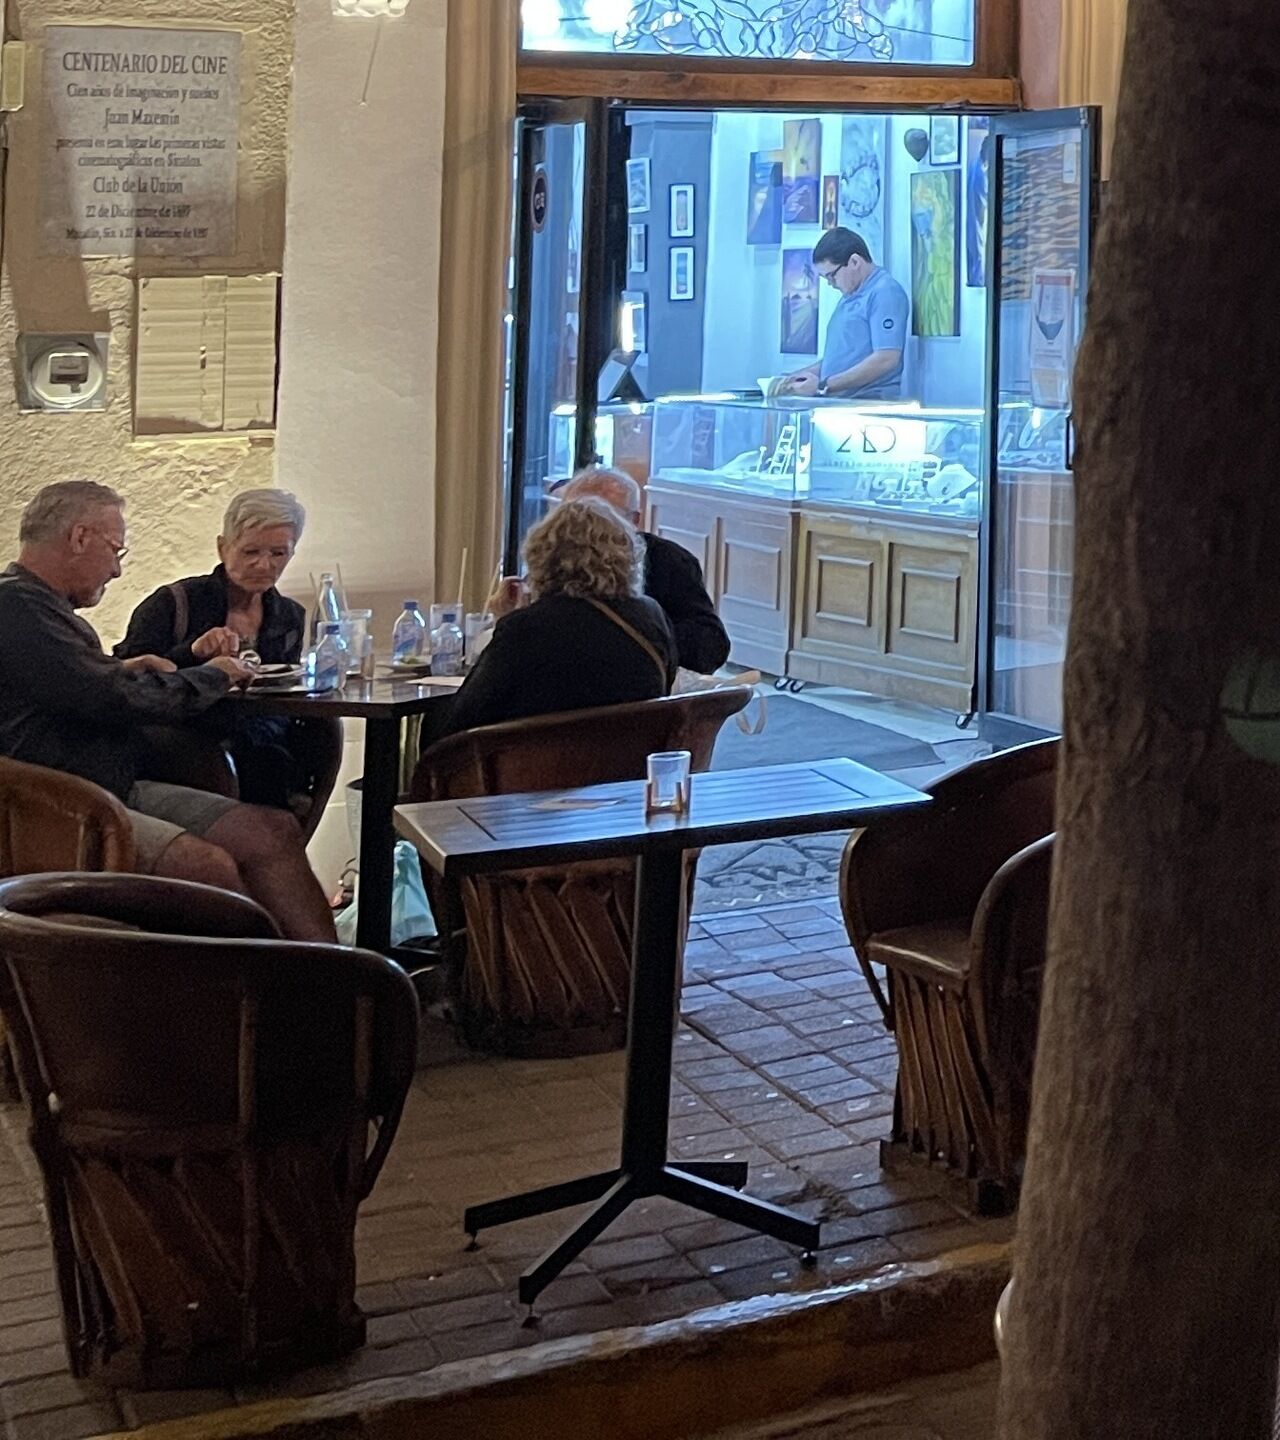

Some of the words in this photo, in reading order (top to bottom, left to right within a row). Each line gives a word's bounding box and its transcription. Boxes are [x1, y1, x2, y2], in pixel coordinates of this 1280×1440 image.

[63, 52, 158, 74] CENTENARIO
[160, 55, 189, 74] DEL
[191, 55, 228, 75] CINE
[67, 83, 89, 98] Cien
[113, 84, 124, 98] de
[181, 88, 187, 103] y
[93, 176, 119, 194] Club
[122, 177, 136, 193] de
[138, 177, 148, 194] la
[150, 176, 184, 195] Unión
[98, 205, 109, 219] de
